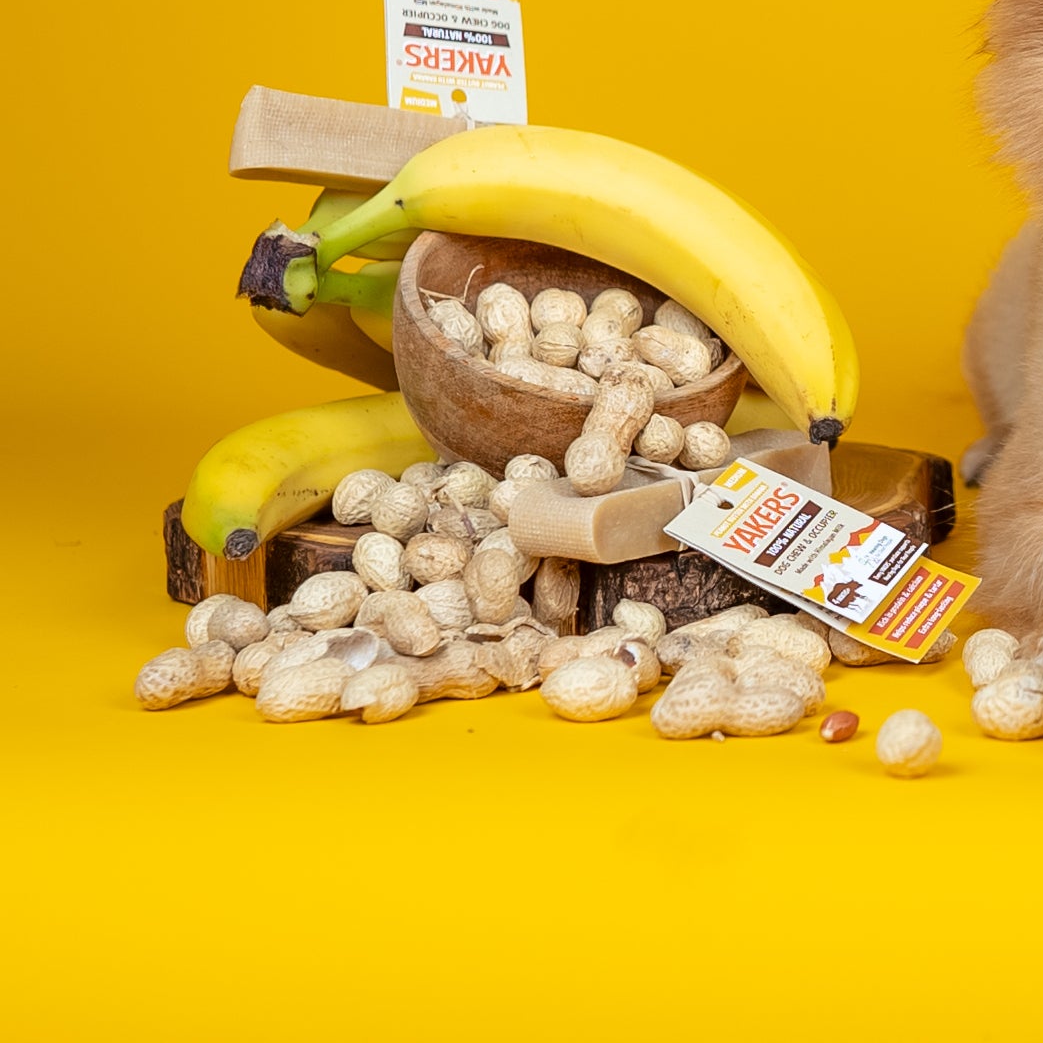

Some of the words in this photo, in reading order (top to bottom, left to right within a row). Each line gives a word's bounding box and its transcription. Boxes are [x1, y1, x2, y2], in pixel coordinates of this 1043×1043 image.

[401, 7, 448, 22] OCCUPIER
[450, 14, 457, 23] &
[460, 15, 488, 28] CHEW
[490, 19, 510, 30] DOG
[420, 24, 462, 42] NATURAL
[463, 30, 493, 45] 100%
[403, 40, 512, 80] YAKERS
[719, 485, 802, 557] YAKERS
[806, 508, 839, 539] OCCUPIER
[764, 535, 790, 557] 100%
[780, 510, 813, 539] NATURAL
[801, 536, 813, 545] &
[784, 542, 807, 562] CHEW
[772, 560, 791, 576] DOG
[926, 578, 944, 593] tartar
[885, 595, 909, 614] protein
[899, 590, 911, 598] &
[916, 619, 933, 635] Extra
